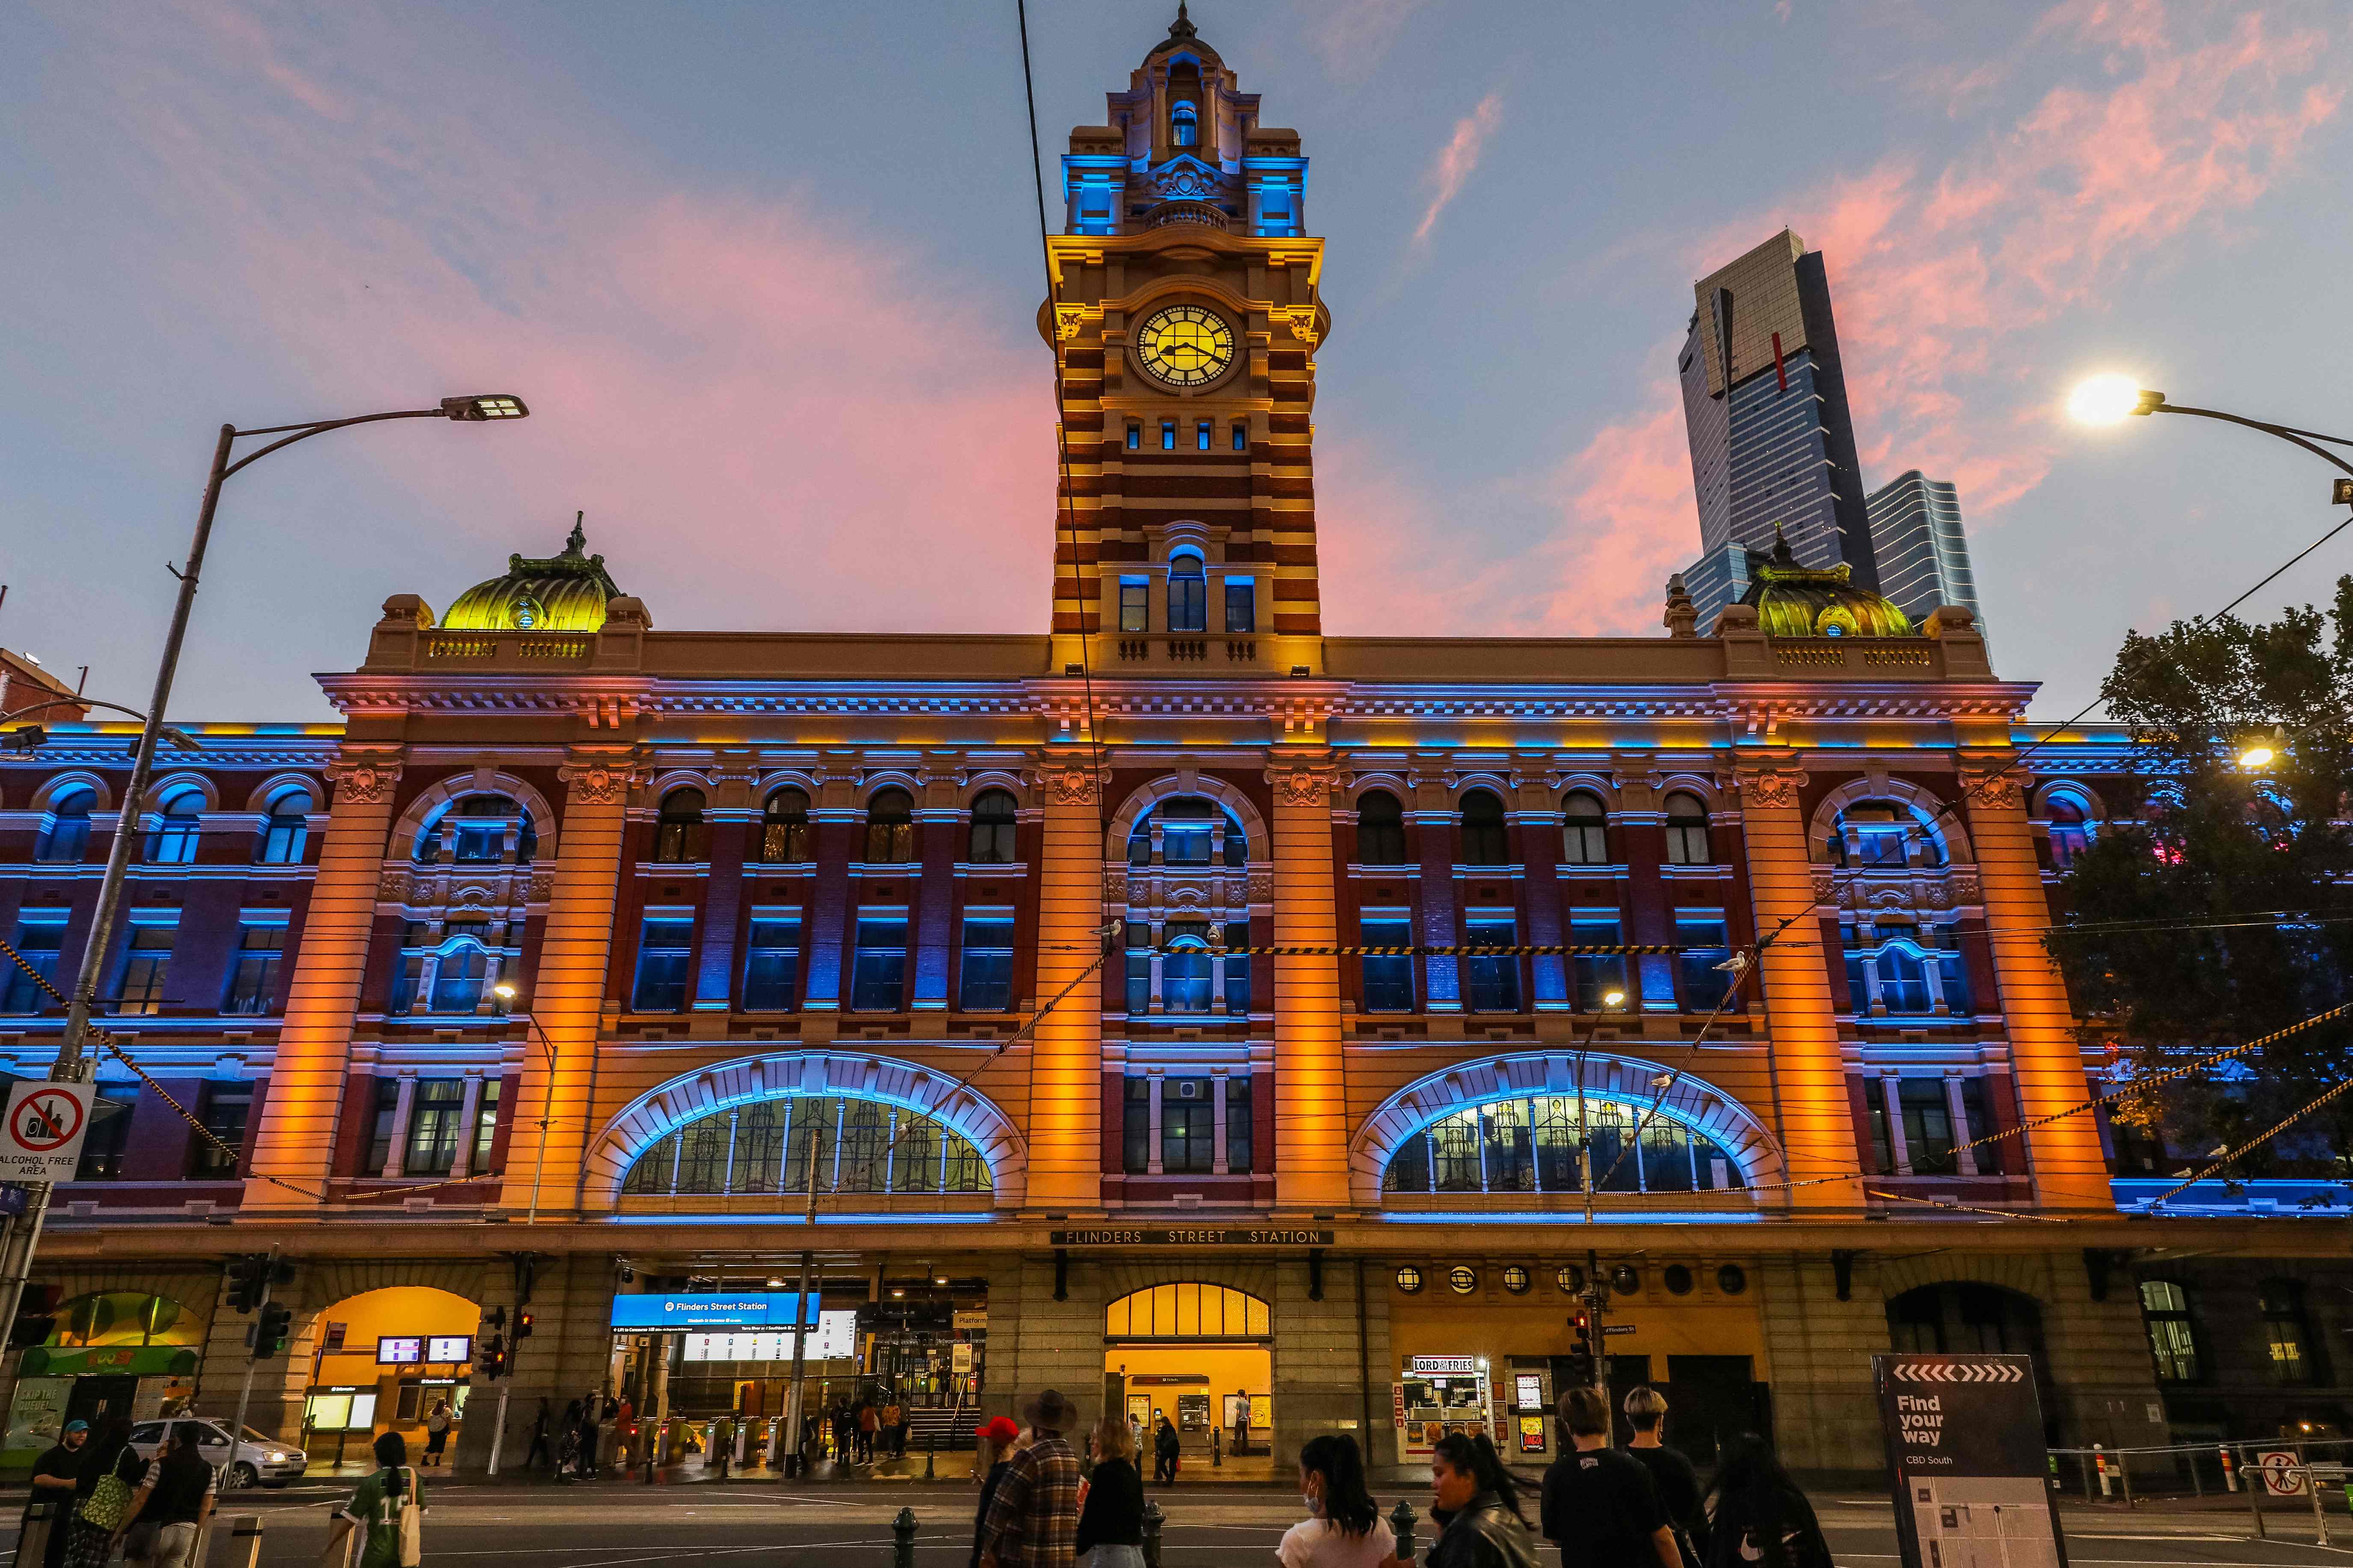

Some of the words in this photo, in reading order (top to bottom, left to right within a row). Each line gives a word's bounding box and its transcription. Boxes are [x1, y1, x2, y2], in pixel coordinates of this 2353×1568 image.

[0, 1156, 44, 1164] ALCOHOL
[48, 1157, 74, 1165] FREE
[1067, 1232, 1141, 1243] FLINDERS
[1169, 1231, 1225, 1242] STREET
[1251, 1231, 1319, 1243] STATION
[1415, 1361, 1439, 1370] LORD
[1448, 1361, 1473, 1370] FRIES
[42, 1390, 57, 1399] THE
[1897, 1395, 1941, 1411] Find
[1899, 1414, 1944, 1430] your
[1902, 1431, 1941, 1447] way
[1906, 1456, 1926, 1464] CBD
[1927, 1456, 1953, 1464] South
